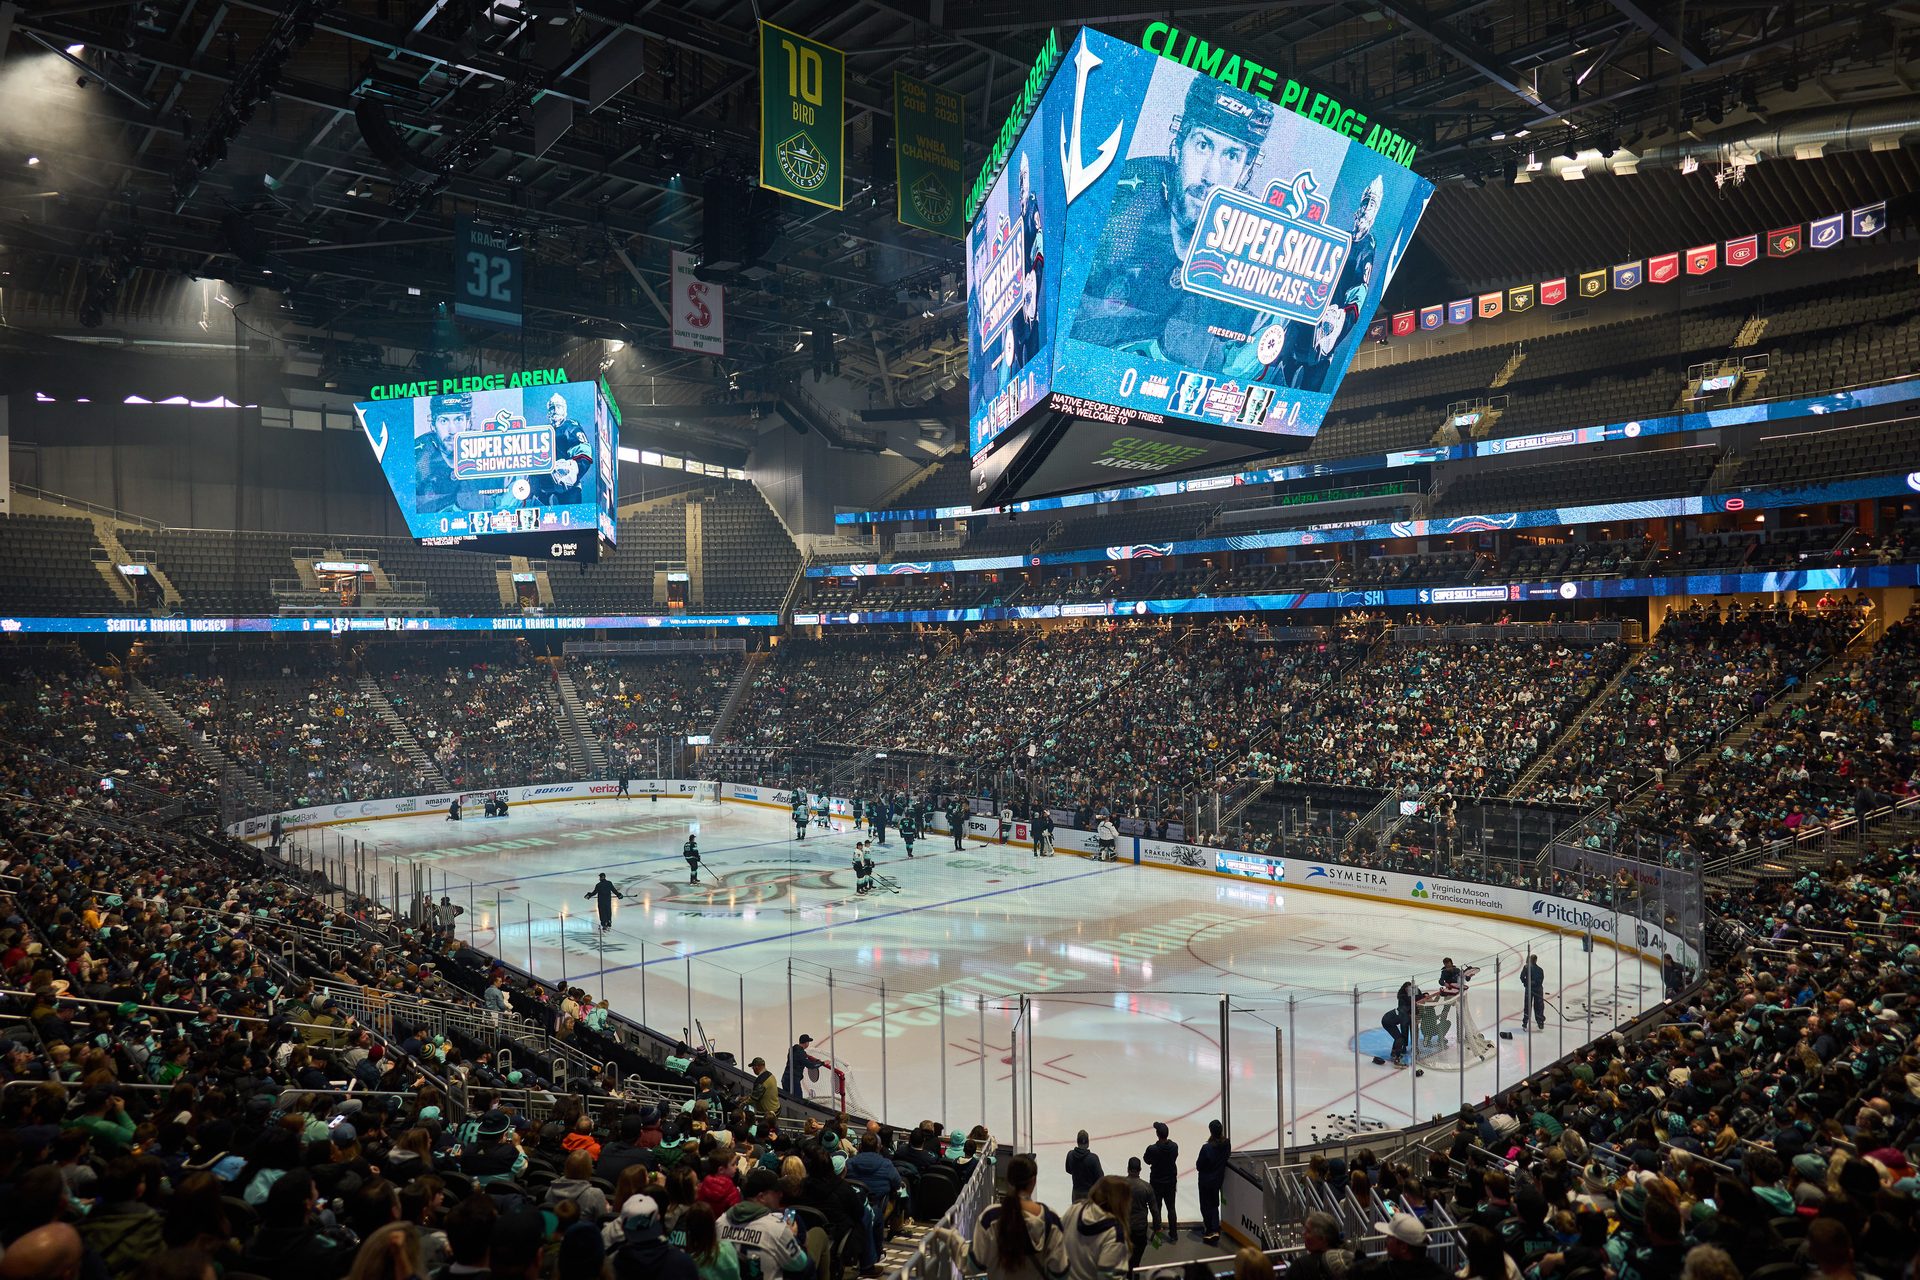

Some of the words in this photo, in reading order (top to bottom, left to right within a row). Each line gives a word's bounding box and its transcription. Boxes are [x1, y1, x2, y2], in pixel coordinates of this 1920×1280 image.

[782, 39, 823, 107] 10
[1142, 21, 1278, 101] CLIMATE
[1279, 79, 1368, 142] PLEDGE
[1363, 123, 1418, 171] ARENA
[1216, 94, 1253, 118] CCM
[792, 101, 815, 126] BIRD
[965, 154, 991, 223] CLIMATE
[992, 93, 1022, 168] PLEDGE
[1023, 26, 1057, 115] ARENA
[916, 134, 946, 154] WNBA
[780, 149, 805, 186] SEATTLE
[807, 162, 826, 187] STORM
[902, 143, 960, 173] CHAMPIONS
[1269, 189, 1286, 206] 20
[1307, 203, 1322, 221] 24
[1206, 204, 1285, 266] SUPER
[1276, 227, 1343, 284] SKILLS
[466, 251, 512, 302] 32
[1221, 259, 1310, 306] SHOWCASE
[1207, 325, 1247, 342] PRESENTED
[370, 380, 438, 401] CLIMATE
[442, 373, 505, 394] PLEDGE
[509, 367, 568, 389] ARENA
[1119, 367, 1138, 398] 0
[1052, 393, 1082, 408] NATIVE
[1083, 399, 1120, 416] PEOPLES
[1120, 407, 1137, 418] AND
[1137, 409, 1164, 424] TRIBES.
[1060, 404, 1075, 415] PA:
[1076, 407, 1117, 424] WELCOME
[1117, 416, 1129, 425] TO
[1287, 401, 1301, 426] 0
[460, 433, 502, 460] SUPER
[503, 430, 550, 455] SKILLS
[1111, 437, 1208, 458] CLIMATE
[1505, 438, 1526, 450] SUPER
[1526, 436, 1546, 447] SKILLS
[476, 455, 533, 472] SHOWCASE
[1091, 456, 1172, 472] ARENA
[1101, 447, 1191, 466] PLEDGE
[440, 517, 449, 533] 0
[561, 510, 570, 527] 0
[1434, 588, 1455, 600] SUPER
[1455, 587, 1476, 599] SKILLS
[1476, 587, 1505, 598] SHOWCASE
[107, 618, 148, 633] SEATTLE
[150, 618, 188, 632] KRAKEN
[190, 618, 227, 632] HOCKEY
[493, 618, 524, 630] SEATTLE
[525, 617, 556, 630] KRAKEN
[557, 616, 586, 629] HOCKEY
[534, 786, 574, 795] BOEING
[589, 784, 624, 795] verizo
[425, 797, 451, 807] amazon
[301, 811, 318, 823] Bank
[1144, 849, 1171, 858] KRAKEN
[1329, 868, 1387, 886] SYMETRA
[1431, 883, 1462, 894] Virginia
[1462, 887, 1490, 899] Mason
[1431, 892, 1475, 906] Franciscan
[1475, 898, 1504, 910] Health
[721, 1225, 763, 1245] DACCORD
